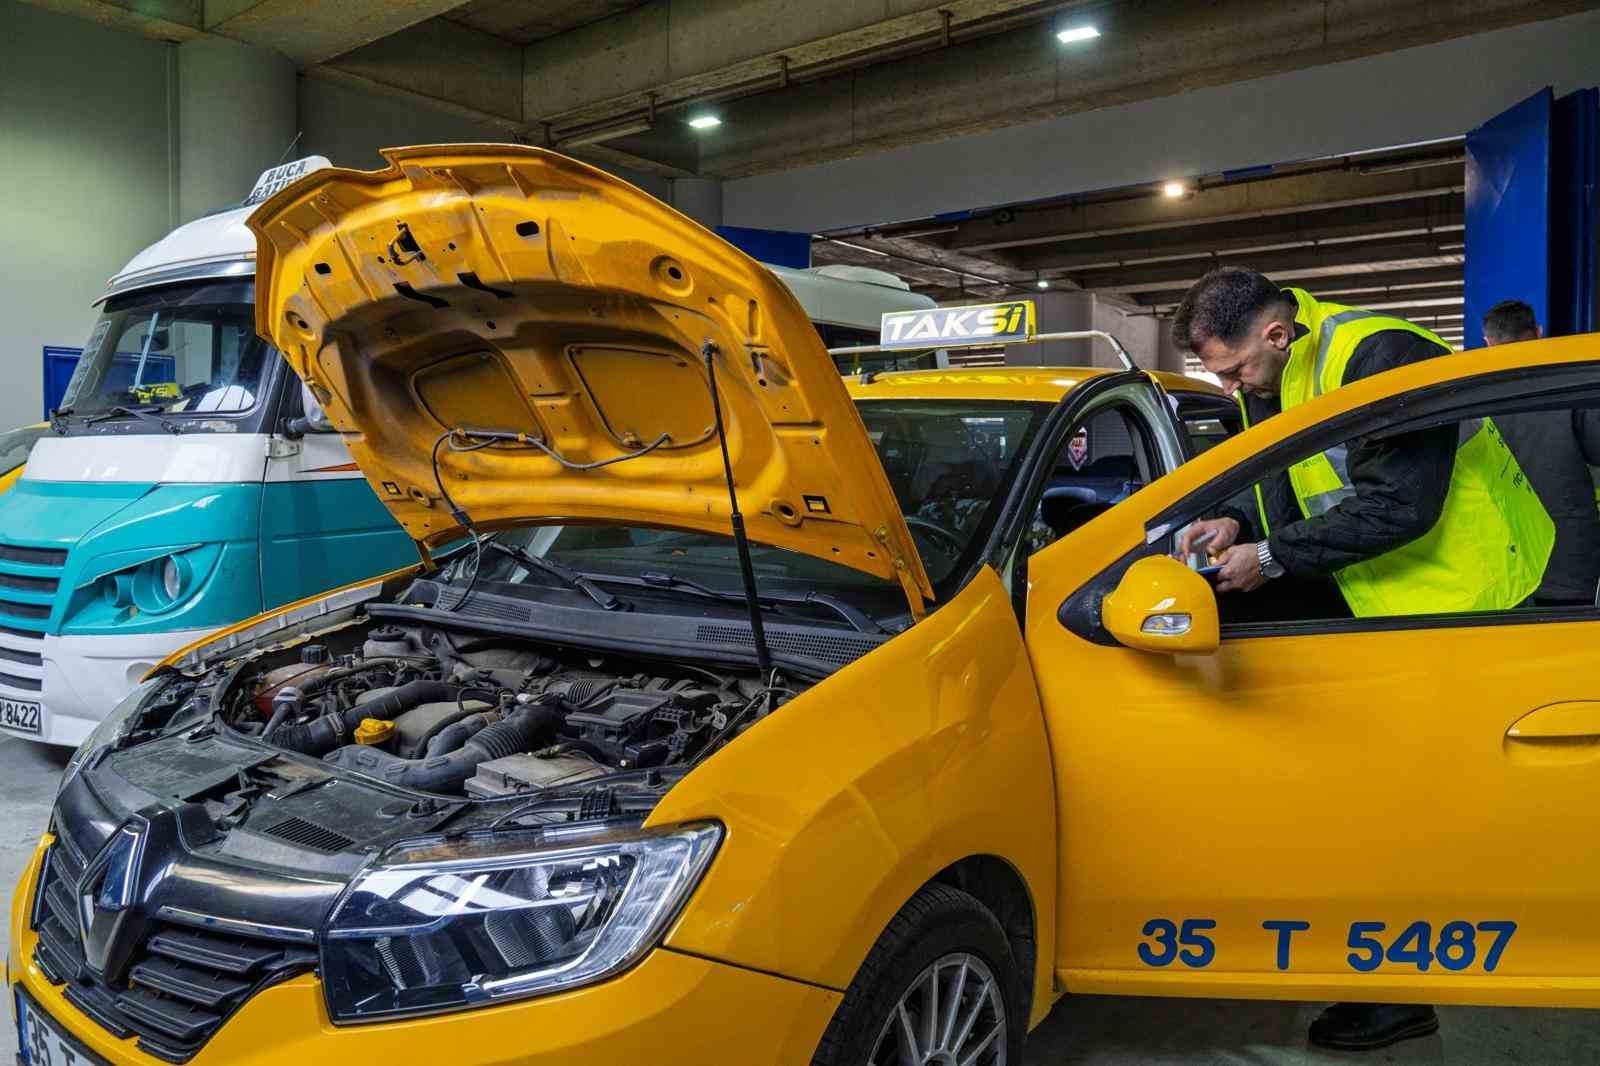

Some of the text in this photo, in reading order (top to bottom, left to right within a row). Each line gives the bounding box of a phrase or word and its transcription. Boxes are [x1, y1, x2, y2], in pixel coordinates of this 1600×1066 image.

[266, 160, 306, 181] BUCA
[1137, 918, 1518, 972] 35 T 5487
[27, 1010, 52, 1066] 35
